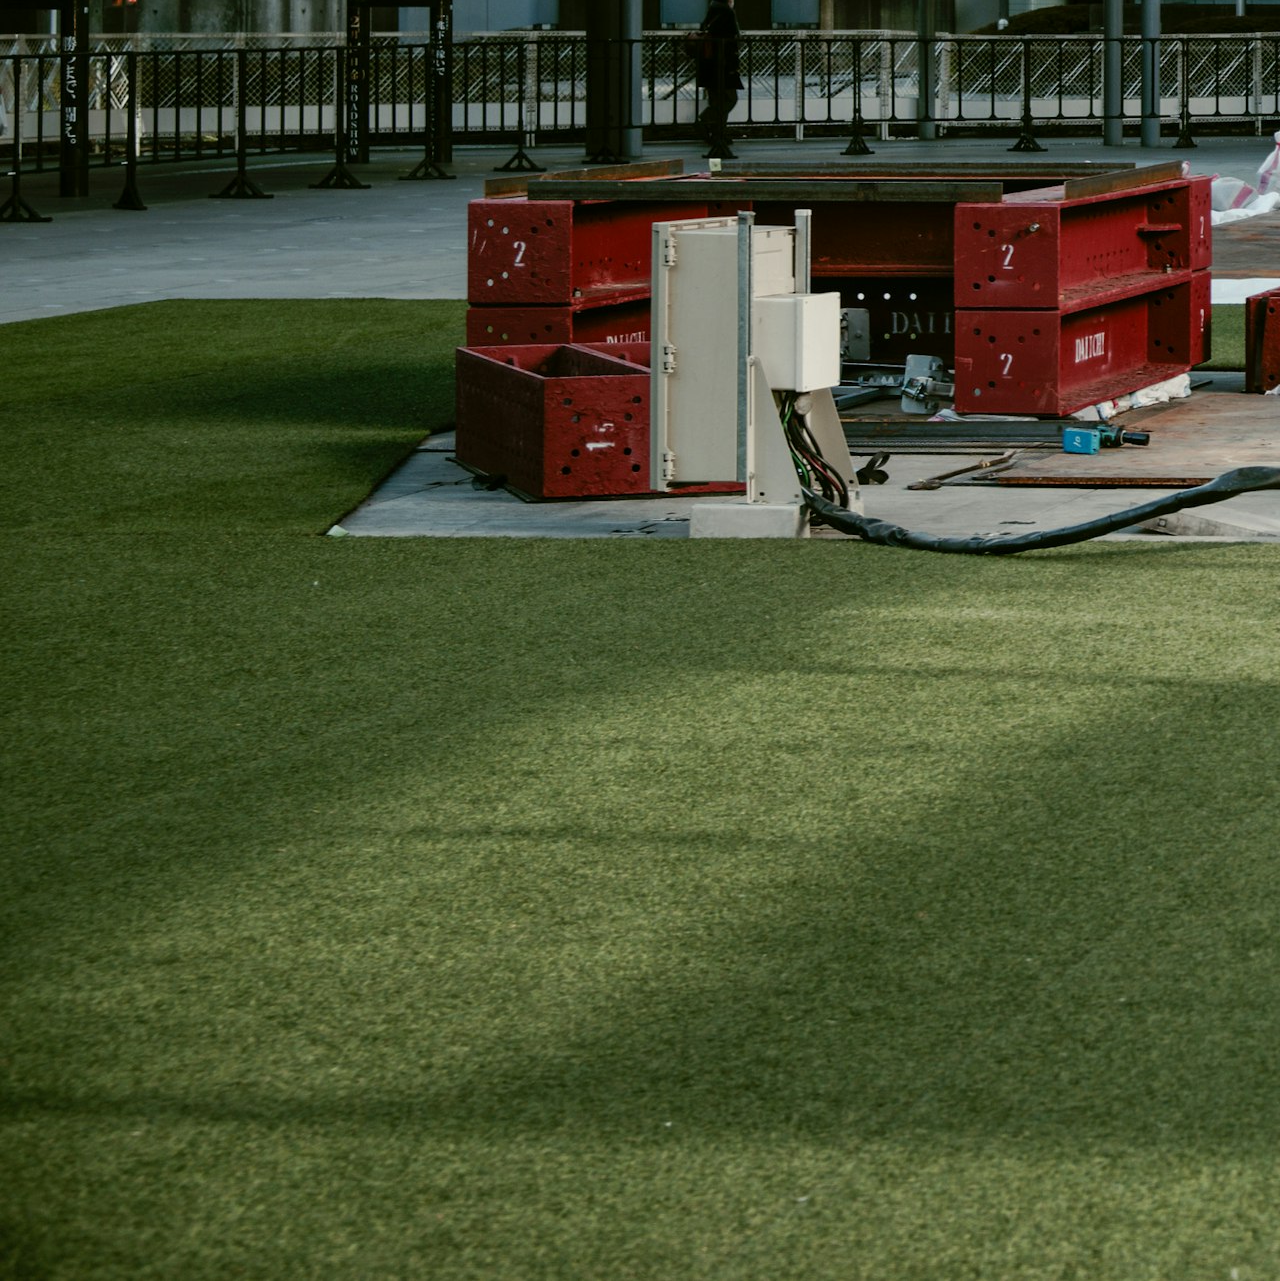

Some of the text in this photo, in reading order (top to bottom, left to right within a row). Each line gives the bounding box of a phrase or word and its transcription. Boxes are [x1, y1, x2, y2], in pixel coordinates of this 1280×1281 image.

[350, 84, 360, 156] ROADSHOW
[513, 241, 527, 267] 2
[1001, 244, 1014, 270] 2
[1075, 331, 1105, 363] DAIICHI
[1000, 353, 1013, 379] 2
